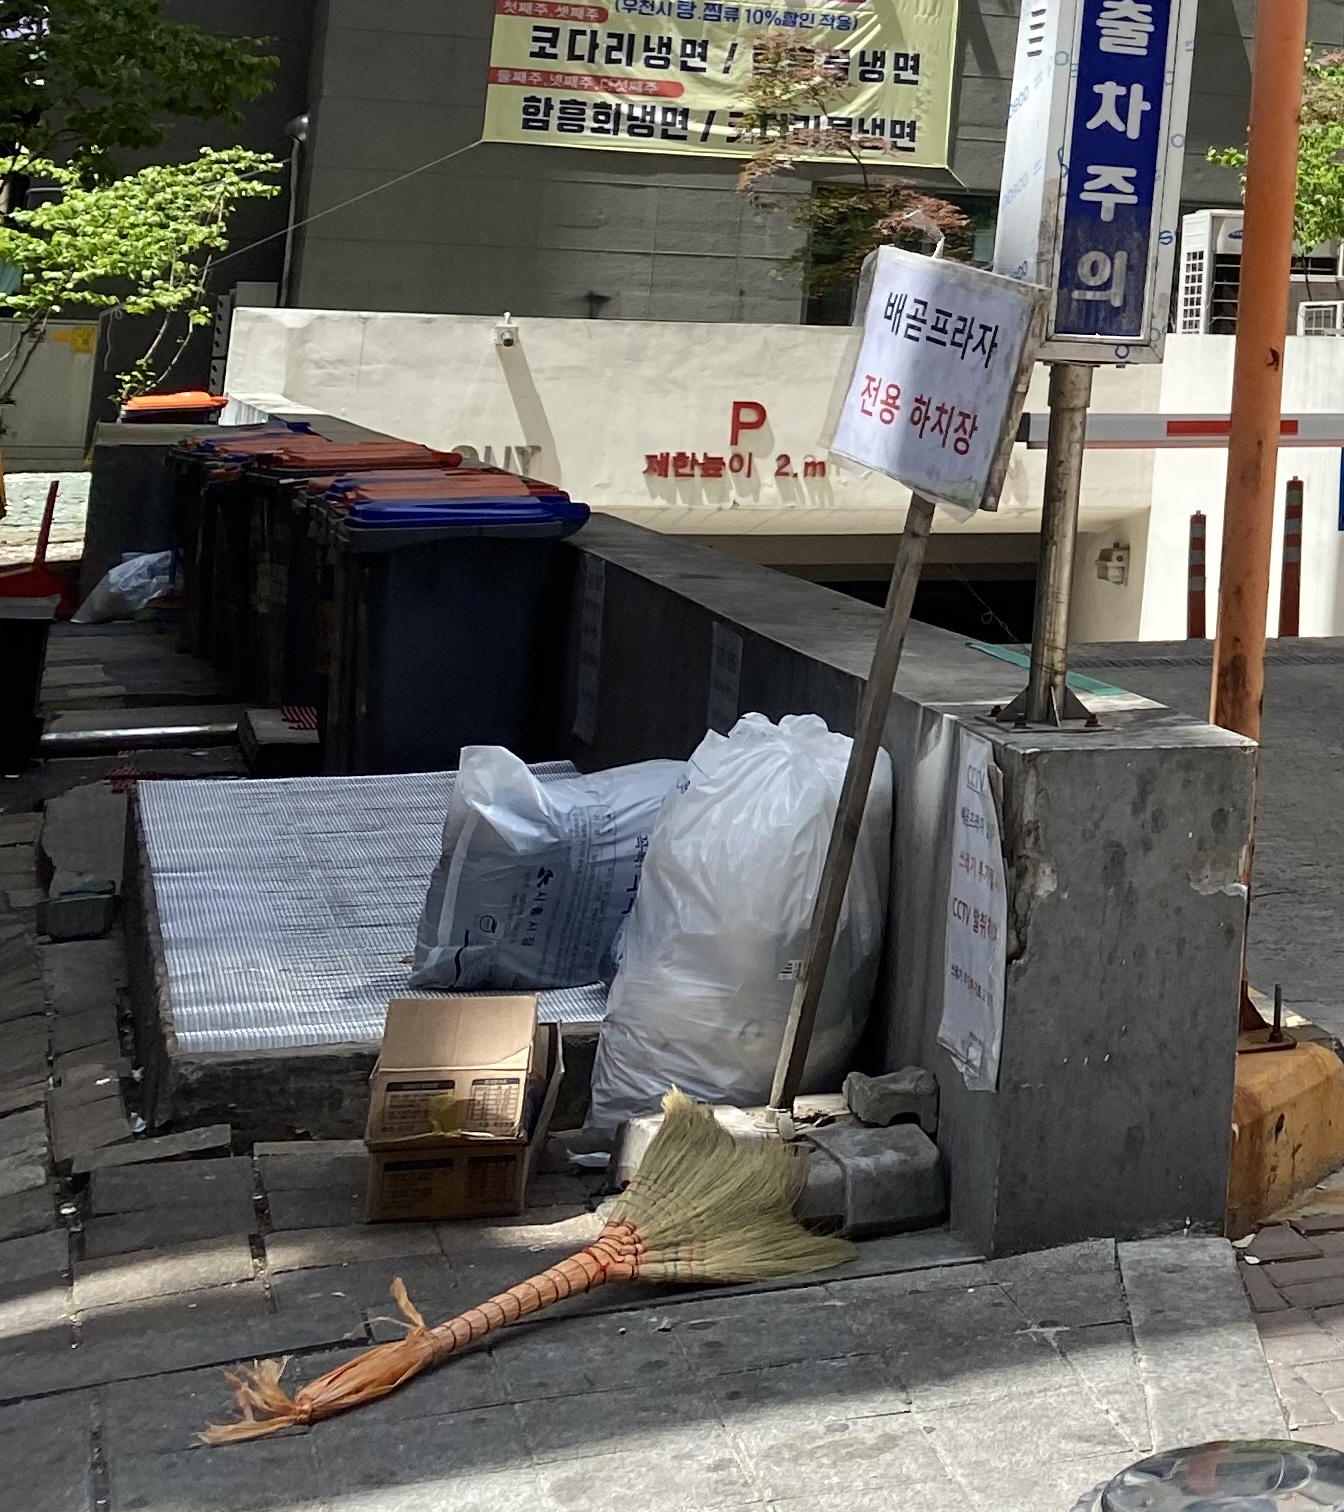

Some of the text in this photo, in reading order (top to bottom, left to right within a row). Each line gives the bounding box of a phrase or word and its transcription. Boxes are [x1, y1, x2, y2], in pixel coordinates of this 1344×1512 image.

[529, 24, 709, 74] 코다리냉면
[521, 94, 690, 141] 함흥회냉면
[730, 400, 767, 447] P
[860, 374, 979, 456] 전용 하치장
[641, 451, 753, 479] 제한높이
[967, 764, 985, 793] CCTV
[952, 896, 972, 925] CCTV
